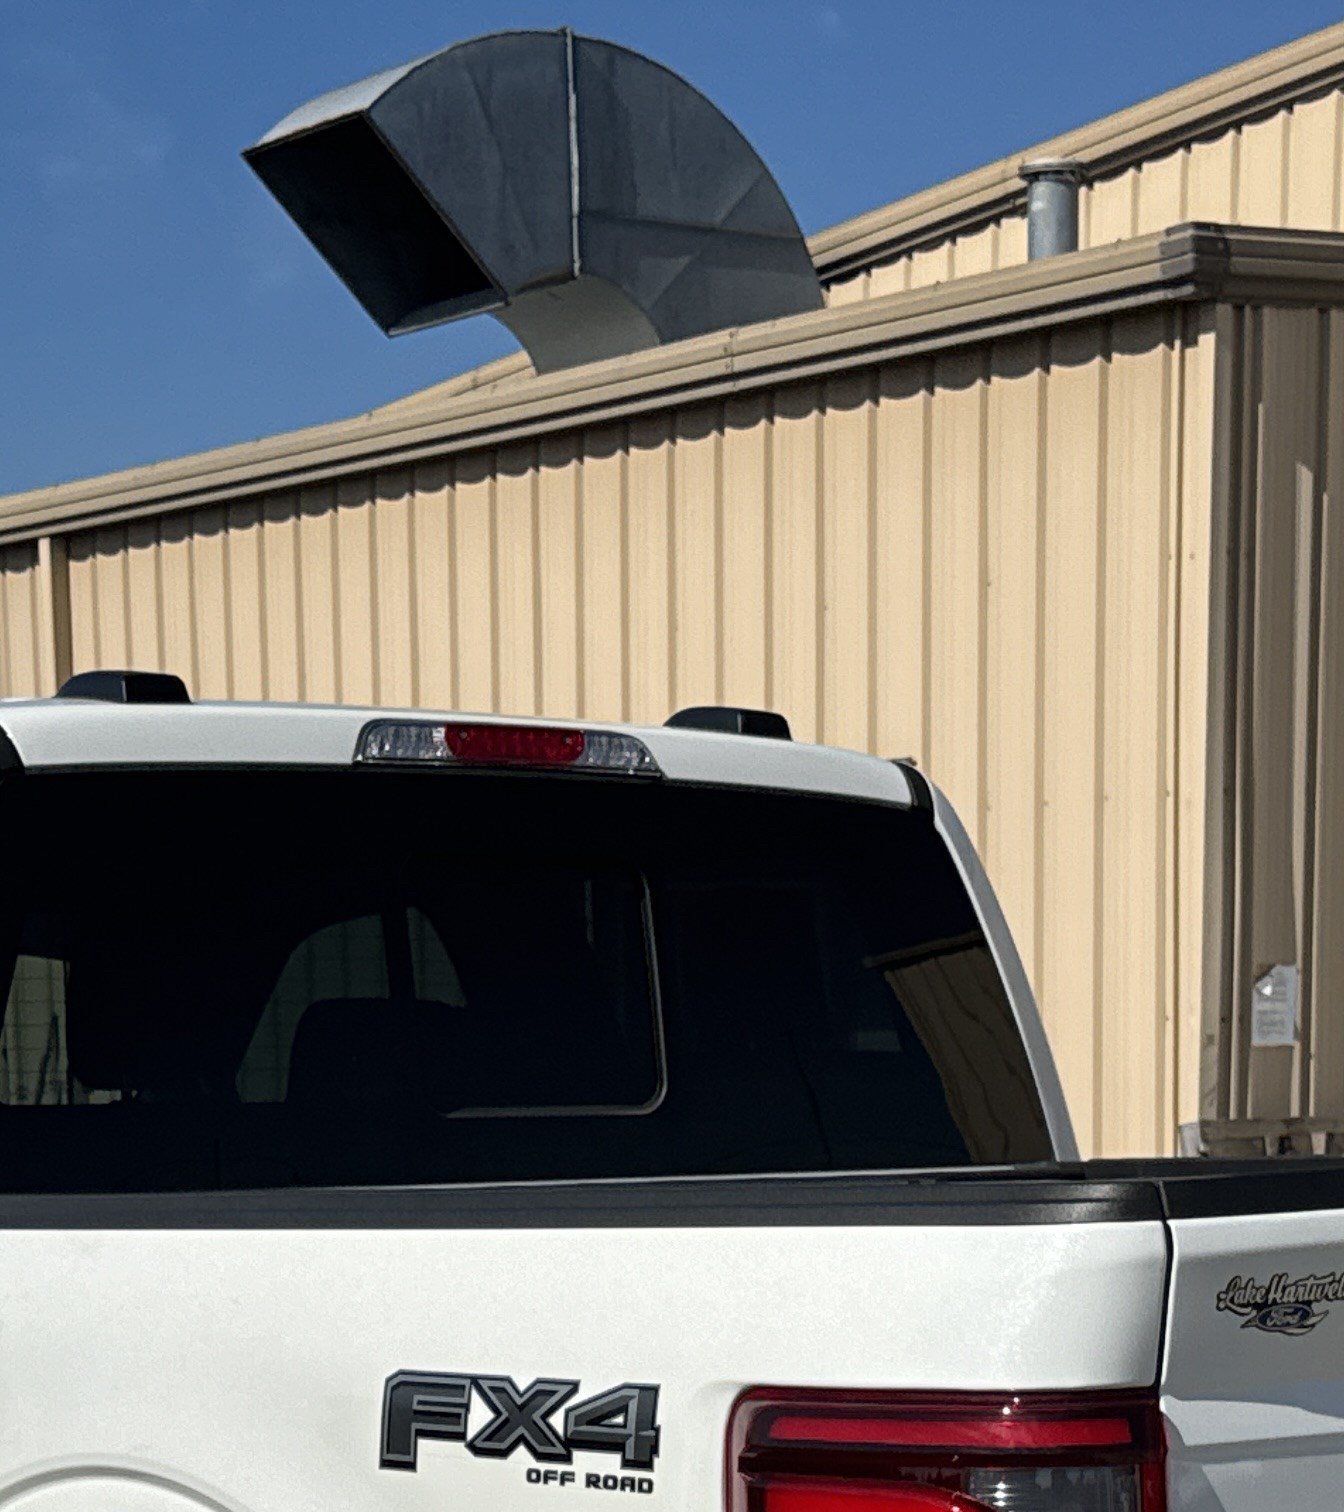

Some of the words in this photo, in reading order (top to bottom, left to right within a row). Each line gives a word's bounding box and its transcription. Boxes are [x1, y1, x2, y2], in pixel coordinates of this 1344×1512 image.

[1216, 1275, 1267, 1316] Lake
[379, 1369, 661, 1472] FX4
[525, 1468, 575, 1487] OFF
[585, 1473, 654, 1494] ROAD
